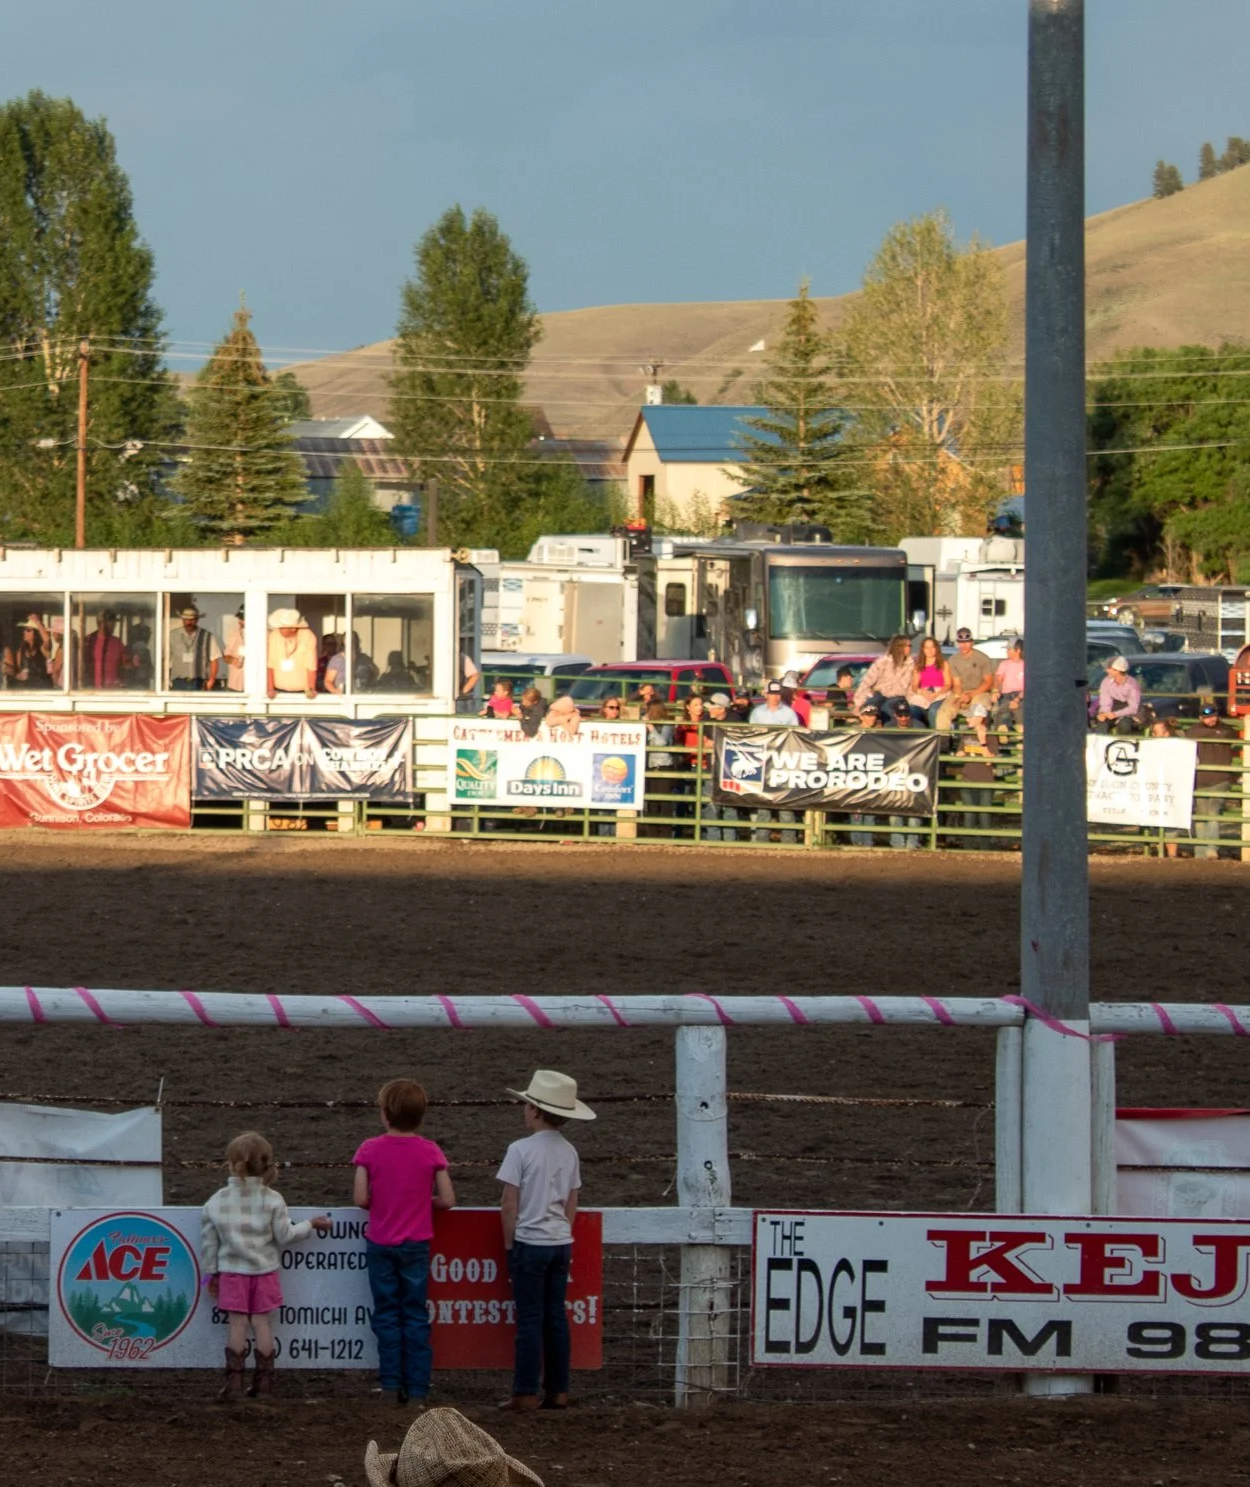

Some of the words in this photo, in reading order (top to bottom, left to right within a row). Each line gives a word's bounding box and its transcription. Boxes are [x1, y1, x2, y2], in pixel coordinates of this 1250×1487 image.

[36, 720, 101, 735] Sponsored
[453, 725, 543, 742] CATEMENS
[550, 728, 584, 743] HOST
[590, 729, 642, 745] HOTELS
[57, 742, 170, 775] Grocer
[217, 748, 291, 770] PRCA
[293, 752, 316, 766] ON
[771, 751, 819, 770] WE
[827, 752, 885, 772] ARE
[456, 779, 496, 792] QUALITY
[510, 780, 551, 796] Days
[553, 783, 580, 796] Inn
[768, 770, 929, 793] PRORODEO
[1132, 780, 1173, 792] CUNY
[1132, 792, 1176, 807] OPANY
[316, 1221, 369, 1240] OWNE
[770, 1220, 806, 1256] THE
[75, 1239, 171, 1282] ACE
[281, 1250, 368, 1270] OPERATED
[430, 1253, 498, 1283] GOOD
[278, 1304, 347, 1325] TOMICHI
[354, 1305, 375, 1325] AV
[425, 1295, 599, 1325] ONTESTS!
[763, 1257, 889, 1356] EDGE
[921, 1316, 1073, 1358] FM
[106, 1337, 156, 1360] 1962
[289, 1338, 364, 1360] 641-1212
